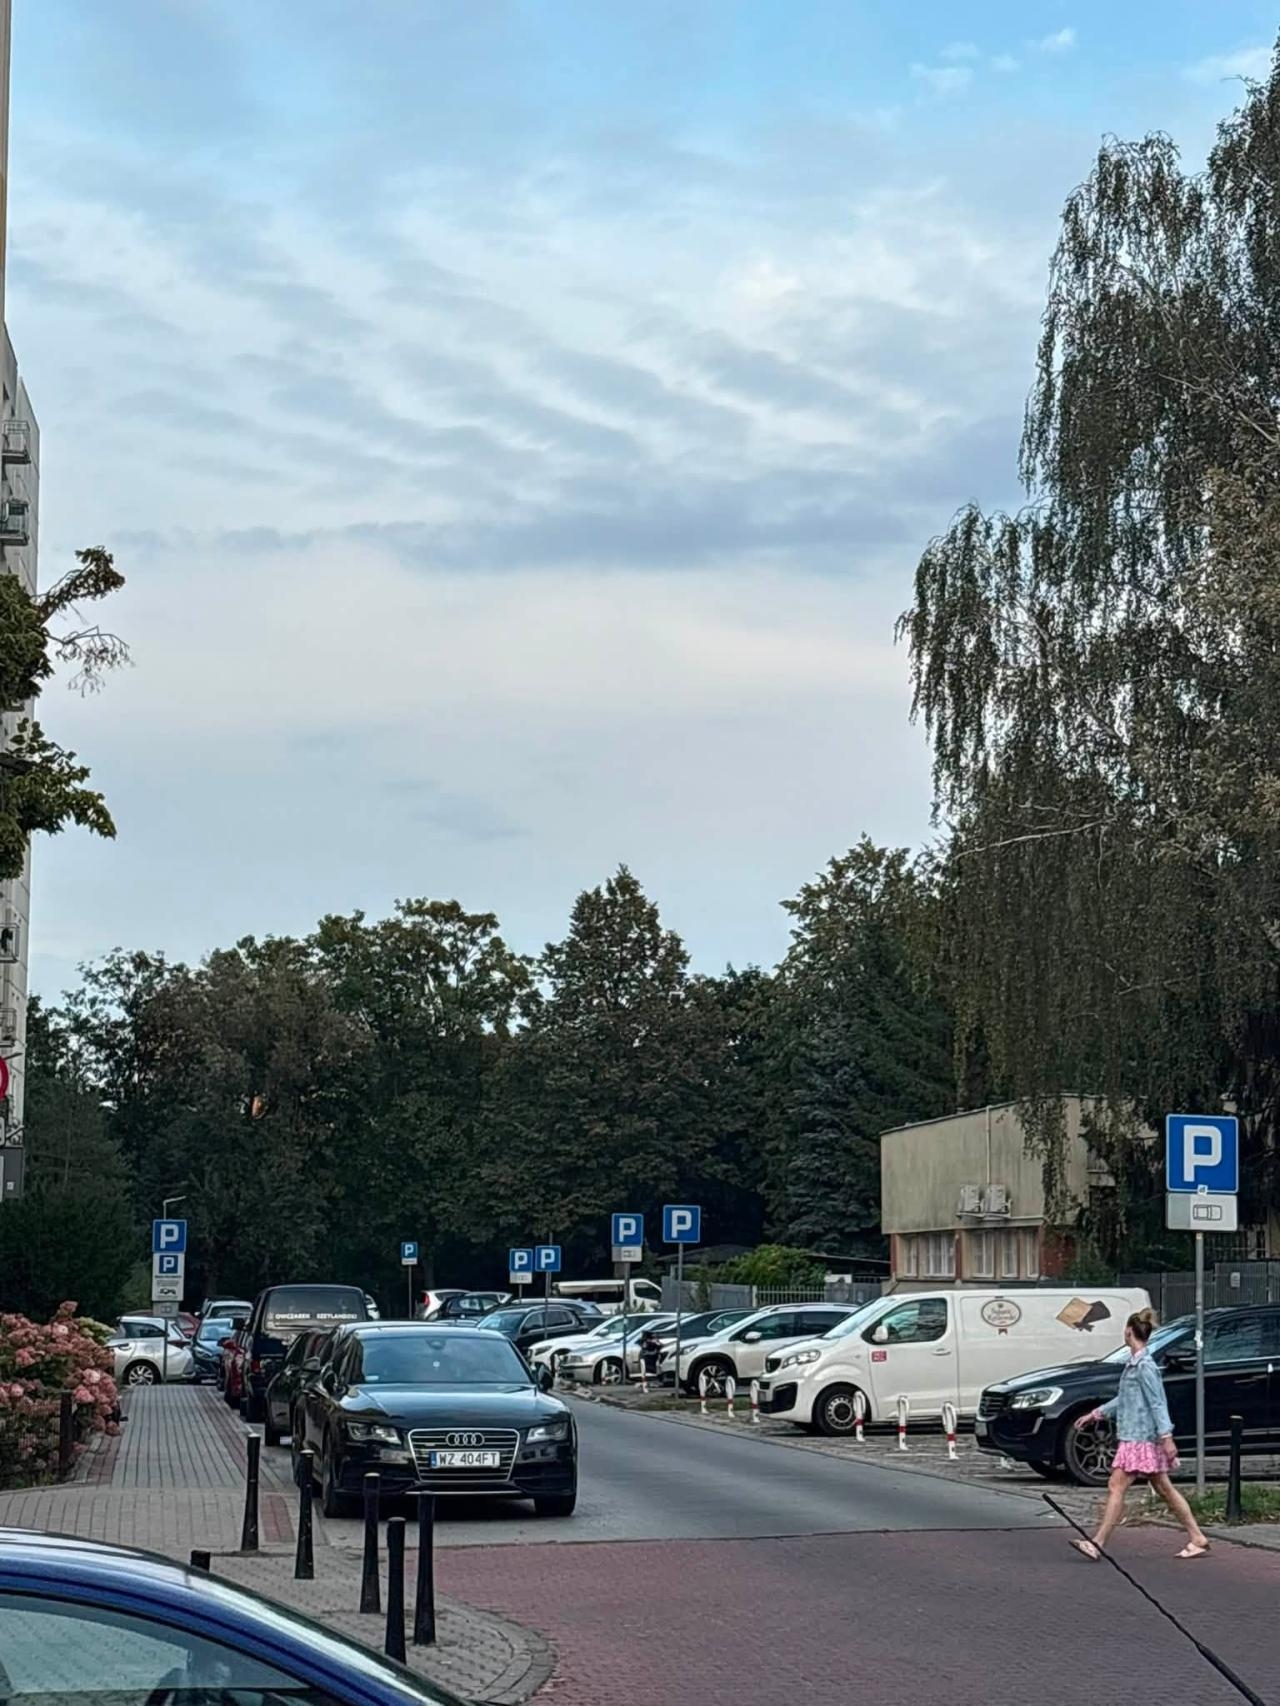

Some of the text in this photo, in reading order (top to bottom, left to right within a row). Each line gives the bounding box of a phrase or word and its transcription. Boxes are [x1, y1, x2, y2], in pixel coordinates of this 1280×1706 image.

[1183, 1124, 1222, 1182] P
[618, 1217, 637, 1243] P
[671, 1209, 692, 1239] P
[159, 1224, 179, 1250] P
[404, 1244, 414, 1257] P
[514, 1251, 528, 1270] P
[540, 1248, 555, 1269] P
[162, 1256, 175, 1272] P
[439, 1452, 498, 1466] WZ 404FT
